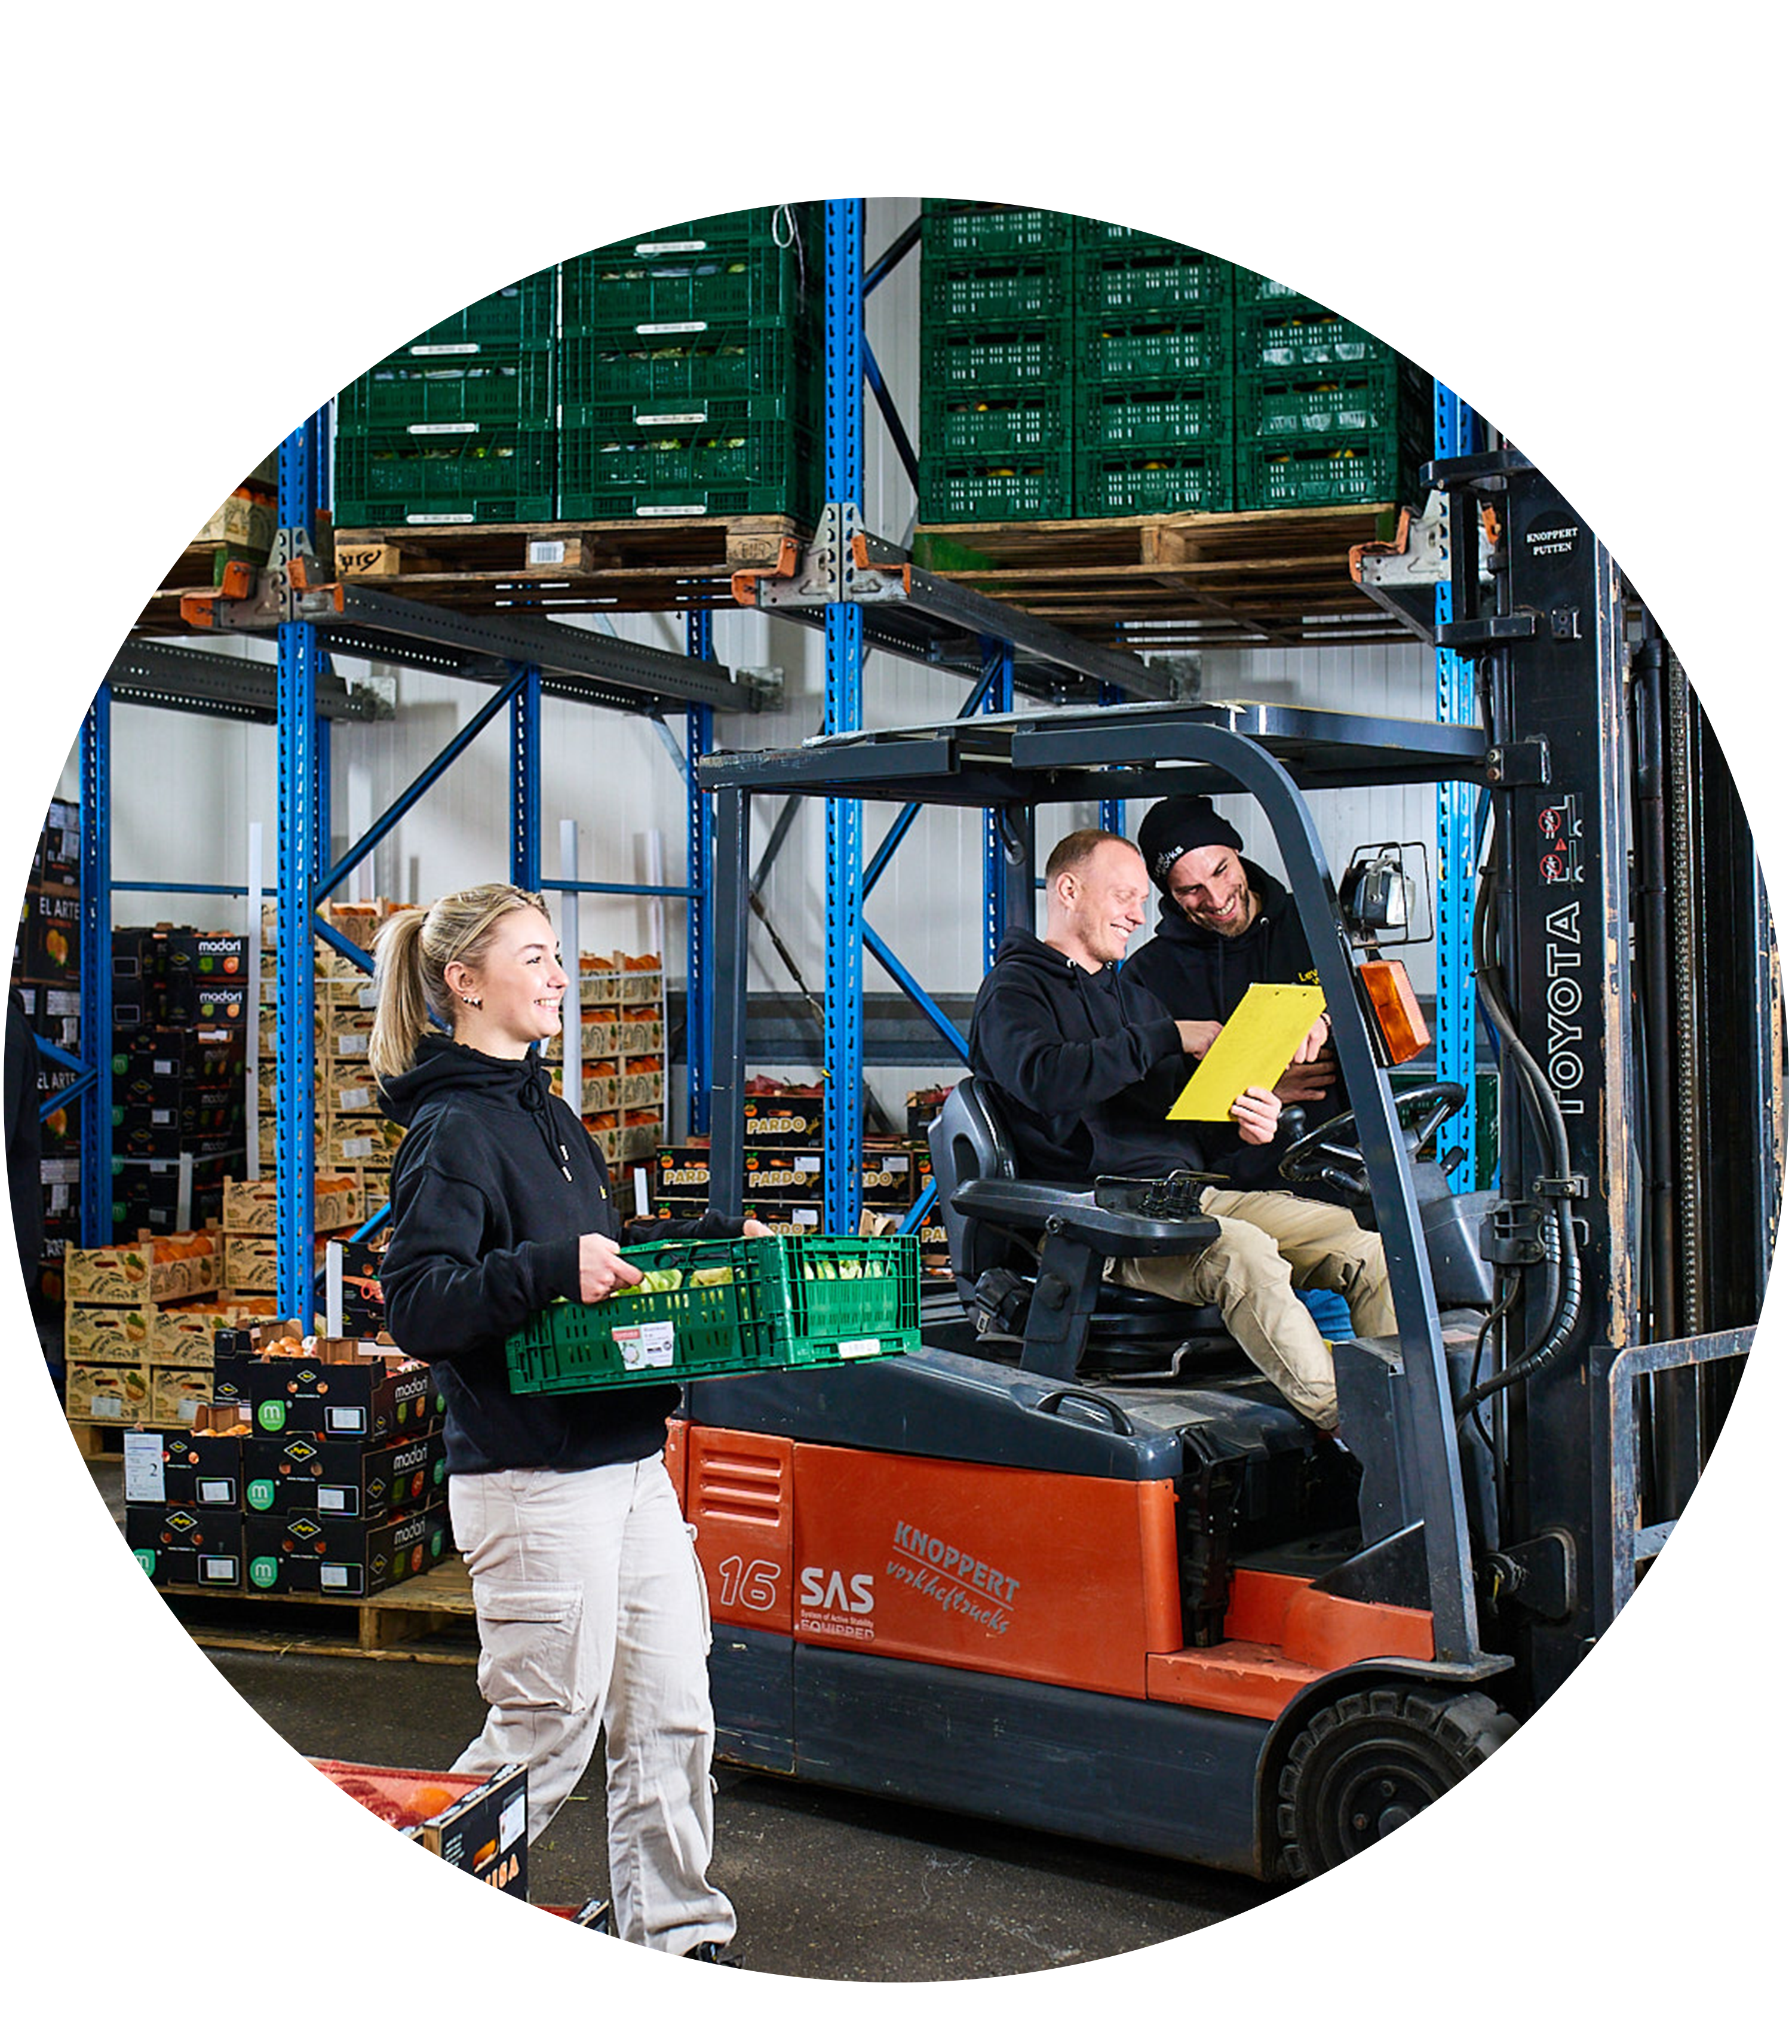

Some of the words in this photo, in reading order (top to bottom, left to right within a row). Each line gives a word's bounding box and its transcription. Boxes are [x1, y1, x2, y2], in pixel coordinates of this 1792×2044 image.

[1526, 527, 1578, 543] KNOPPERT
[1533, 542, 1572, 555] PUTTEN
[39, 897, 51, 915] EL
[53, 898, 80, 920] ARTE
[198, 938, 241, 952] madari
[200, 990, 242, 1003] madari
[747, 1116, 806, 1134] PARDO
[663, 1169, 710, 1186] PARD
[748, 1171, 806, 1188] PARDO
[395, 1376, 429, 1400] madari
[393, 1444, 428, 1470] madari
[394, 1517, 426, 1545] madari
[894, 1521, 1020, 1603] KNOPPERT
[719, 1555, 781, 1612] 16
[800, 1566, 875, 1614] SAS
